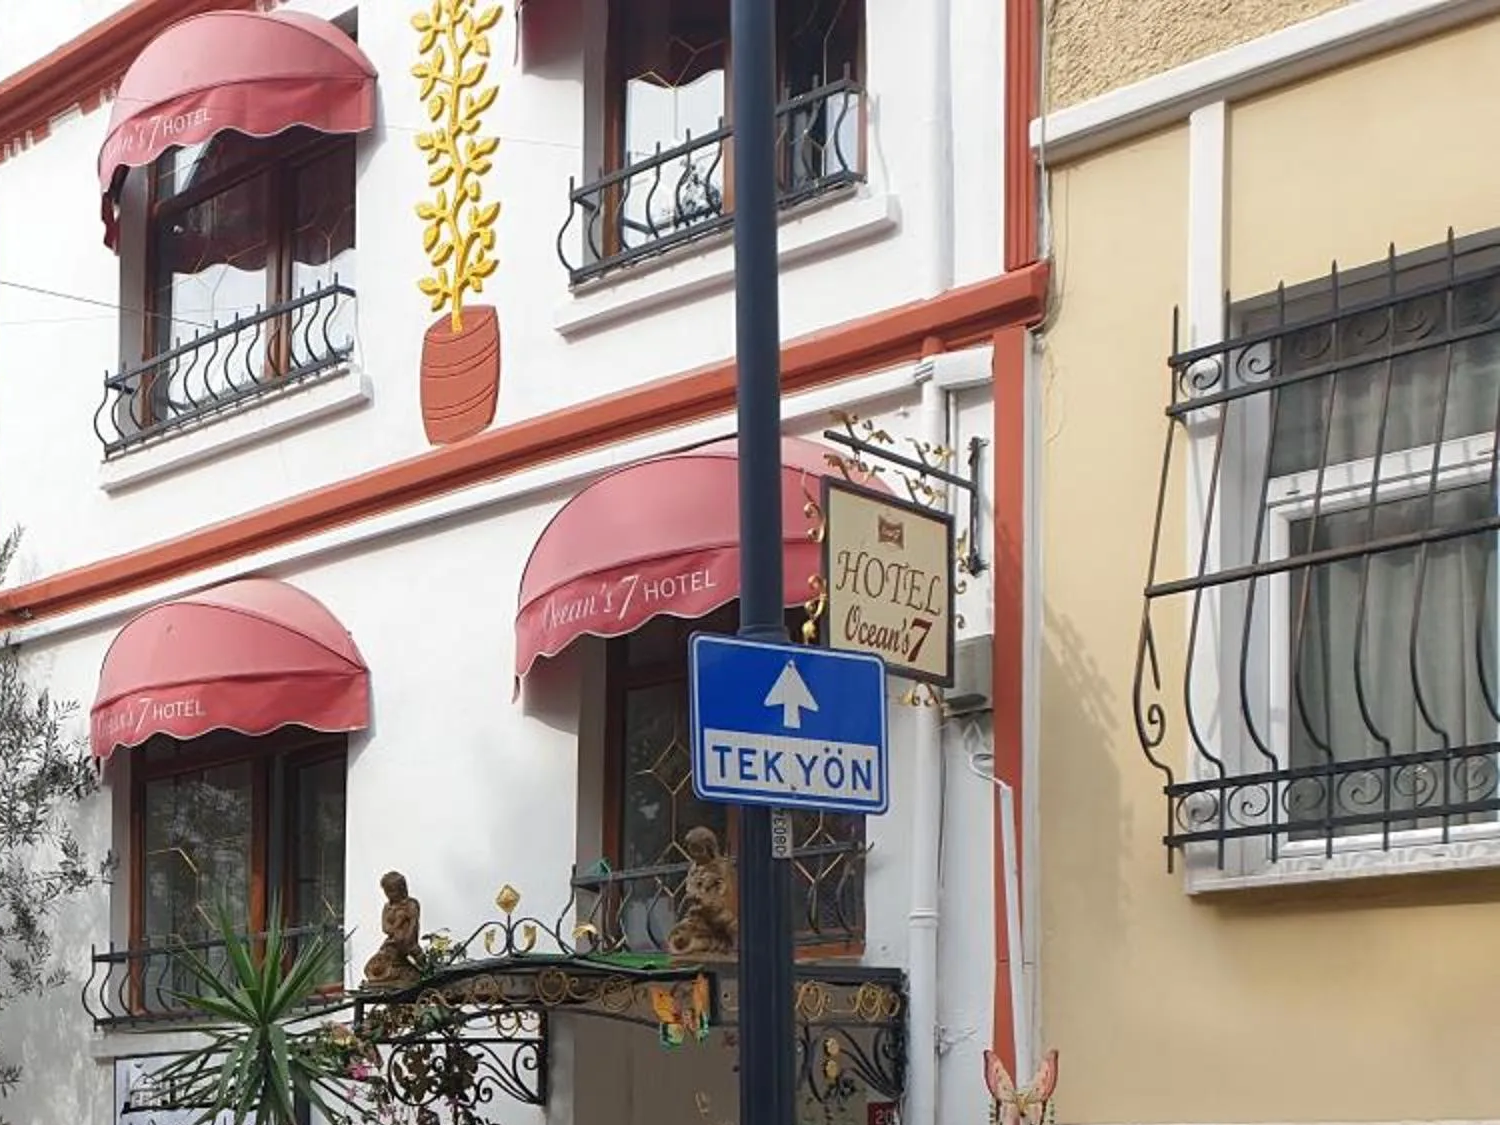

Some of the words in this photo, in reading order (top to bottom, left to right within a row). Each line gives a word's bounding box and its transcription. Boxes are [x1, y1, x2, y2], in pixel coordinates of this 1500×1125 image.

[162, 107, 212, 137] HOTEL
[643, 568, 717, 603] HOTEL
[835, 550, 941, 617] HOTEL
[153, 698, 207, 722] HOTEL
[712, 745, 785, 784] TEK
[795, 747, 873, 792] YÖN
